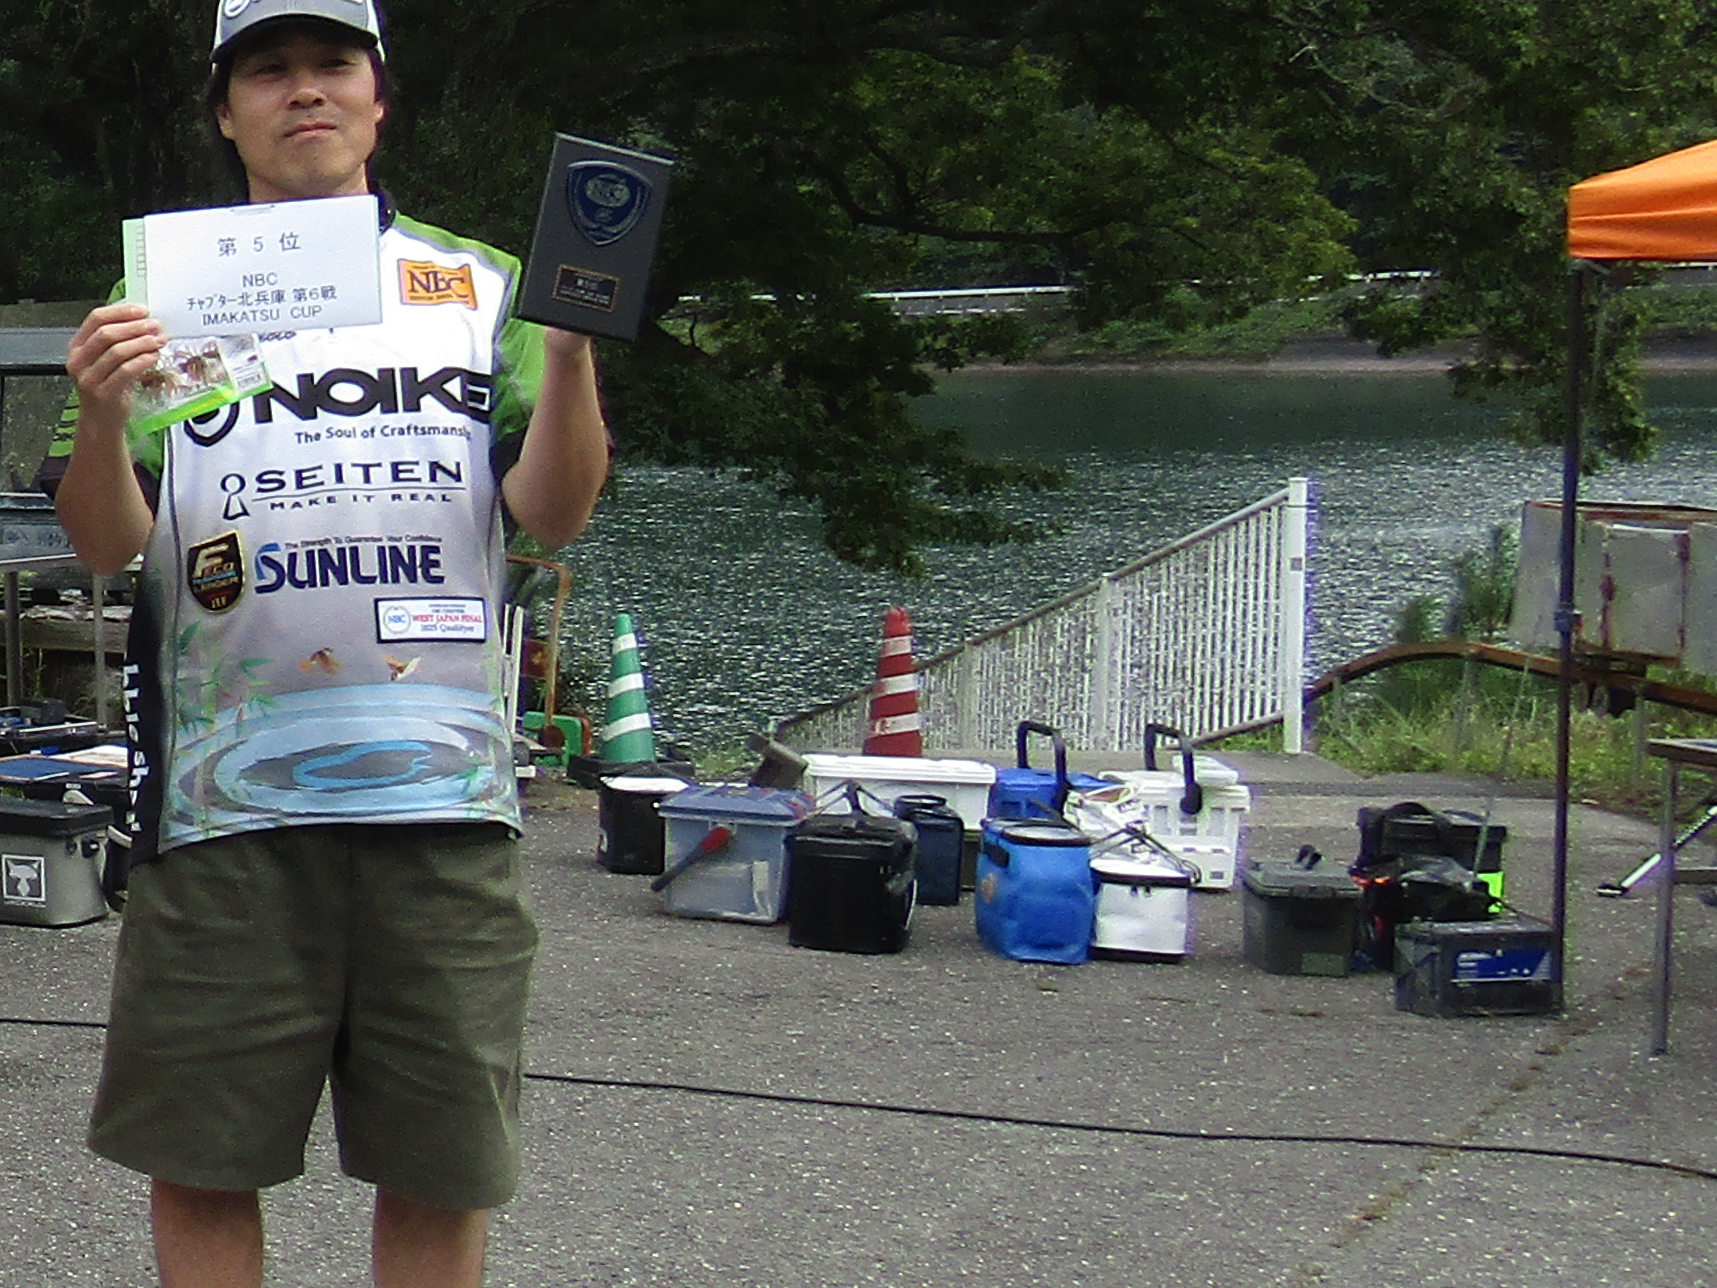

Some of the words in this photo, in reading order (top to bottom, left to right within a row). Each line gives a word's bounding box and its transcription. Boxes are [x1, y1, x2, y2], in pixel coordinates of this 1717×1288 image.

[242, 272, 278, 289] NBC
[406, 270, 469, 299] NBC
[294, 284, 338, 303] 第6戦
[203, 309, 280, 326] IMAKATSU
[290, 304, 323, 319] CUP
[252, 367, 492, 425] NOIKE
[296, 432, 321, 445] The
[326, 426, 357, 440] Soul
[361, 425, 376, 439] of
[255, 460, 463, 493] SEITEN
[270, 496, 337, 511] MAKE
[352, 494, 375, 503] IT
[391, 493, 452, 503] REAL
[254, 542, 445, 594] SUNLINE
